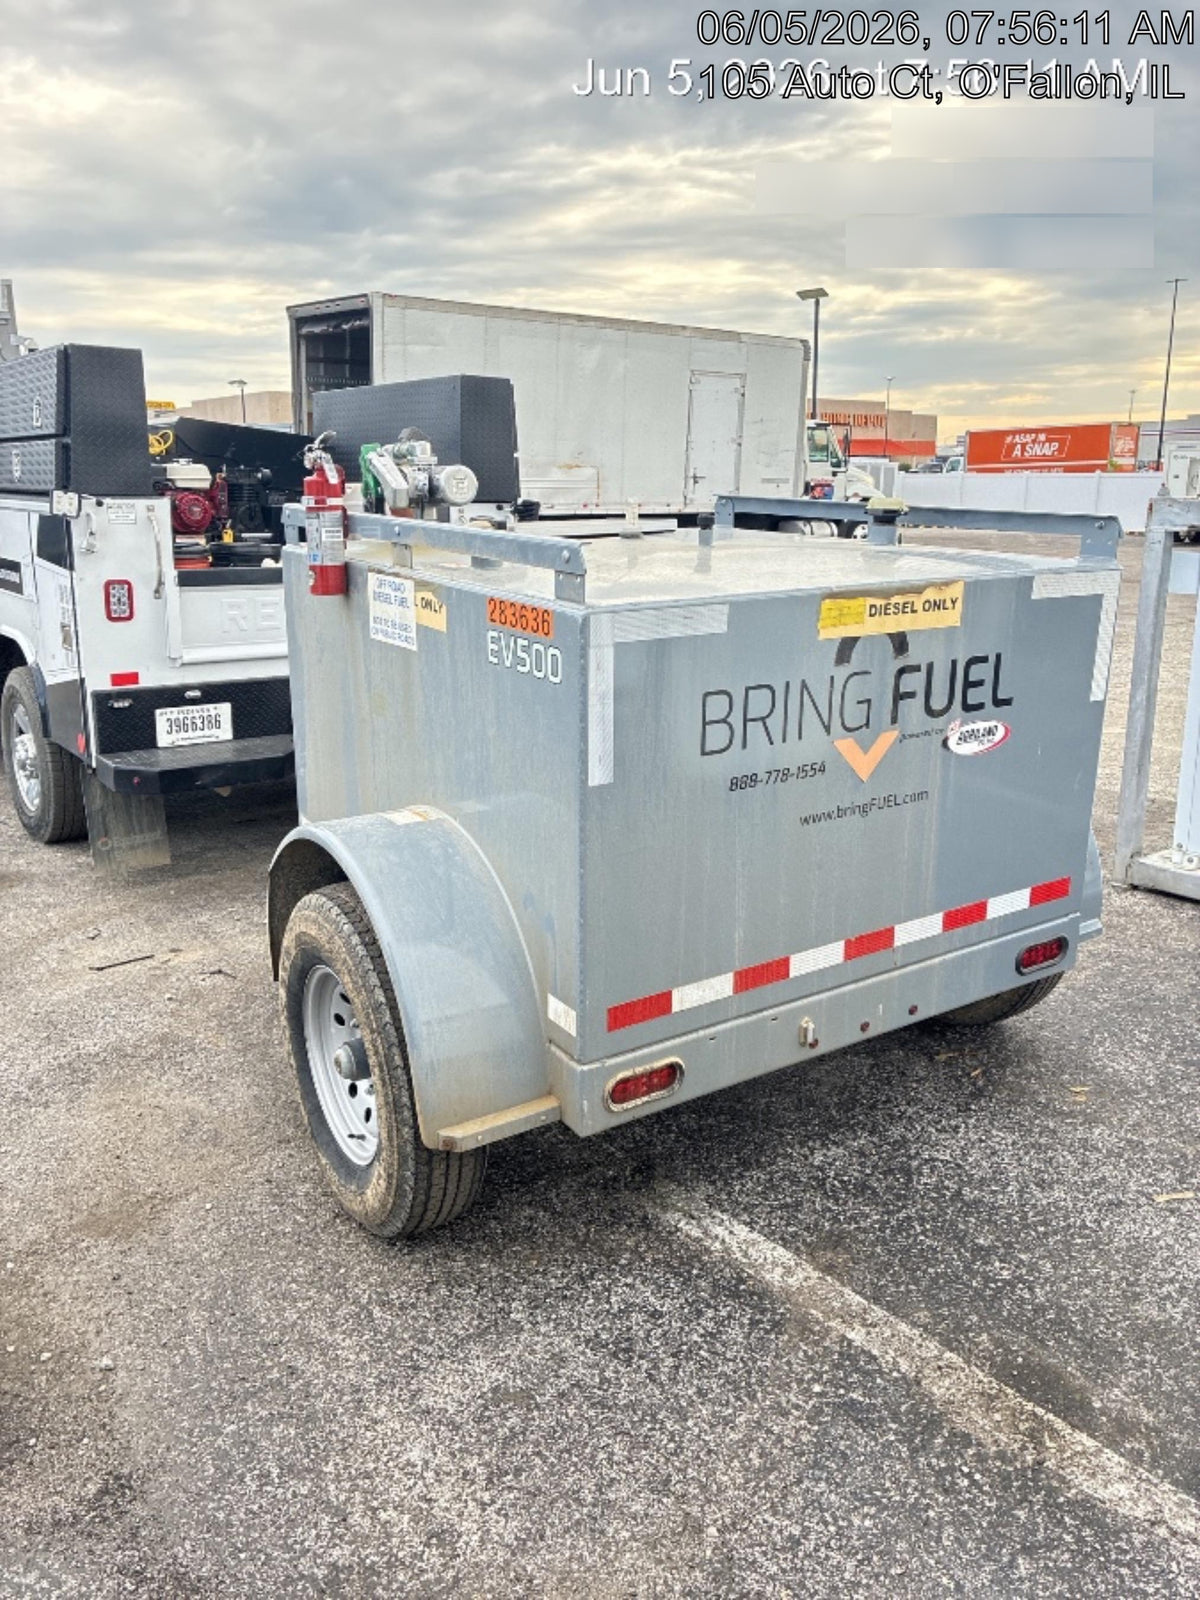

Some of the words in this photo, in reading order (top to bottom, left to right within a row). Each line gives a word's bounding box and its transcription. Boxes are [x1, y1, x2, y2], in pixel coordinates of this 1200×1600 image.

[1011, 444, 1022, 458] A
[1023, 442, 1059, 457] SNAP.
[420, 597, 443, 615] ONLY
[488, 598, 551, 637] 283636
[868, 600, 918, 618] DIESEL
[922, 596, 959, 613] ONLY
[487, 629, 562, 684] EV500
[700, 669, 873, 757] BRING
[890, 652, 1014, 726] FUEL
[166, 712, 222, 735] 3966386
[728, 760, 826, 792] 888-778-1554
[799, 789, 930, 827] www.bringFUEL.com
